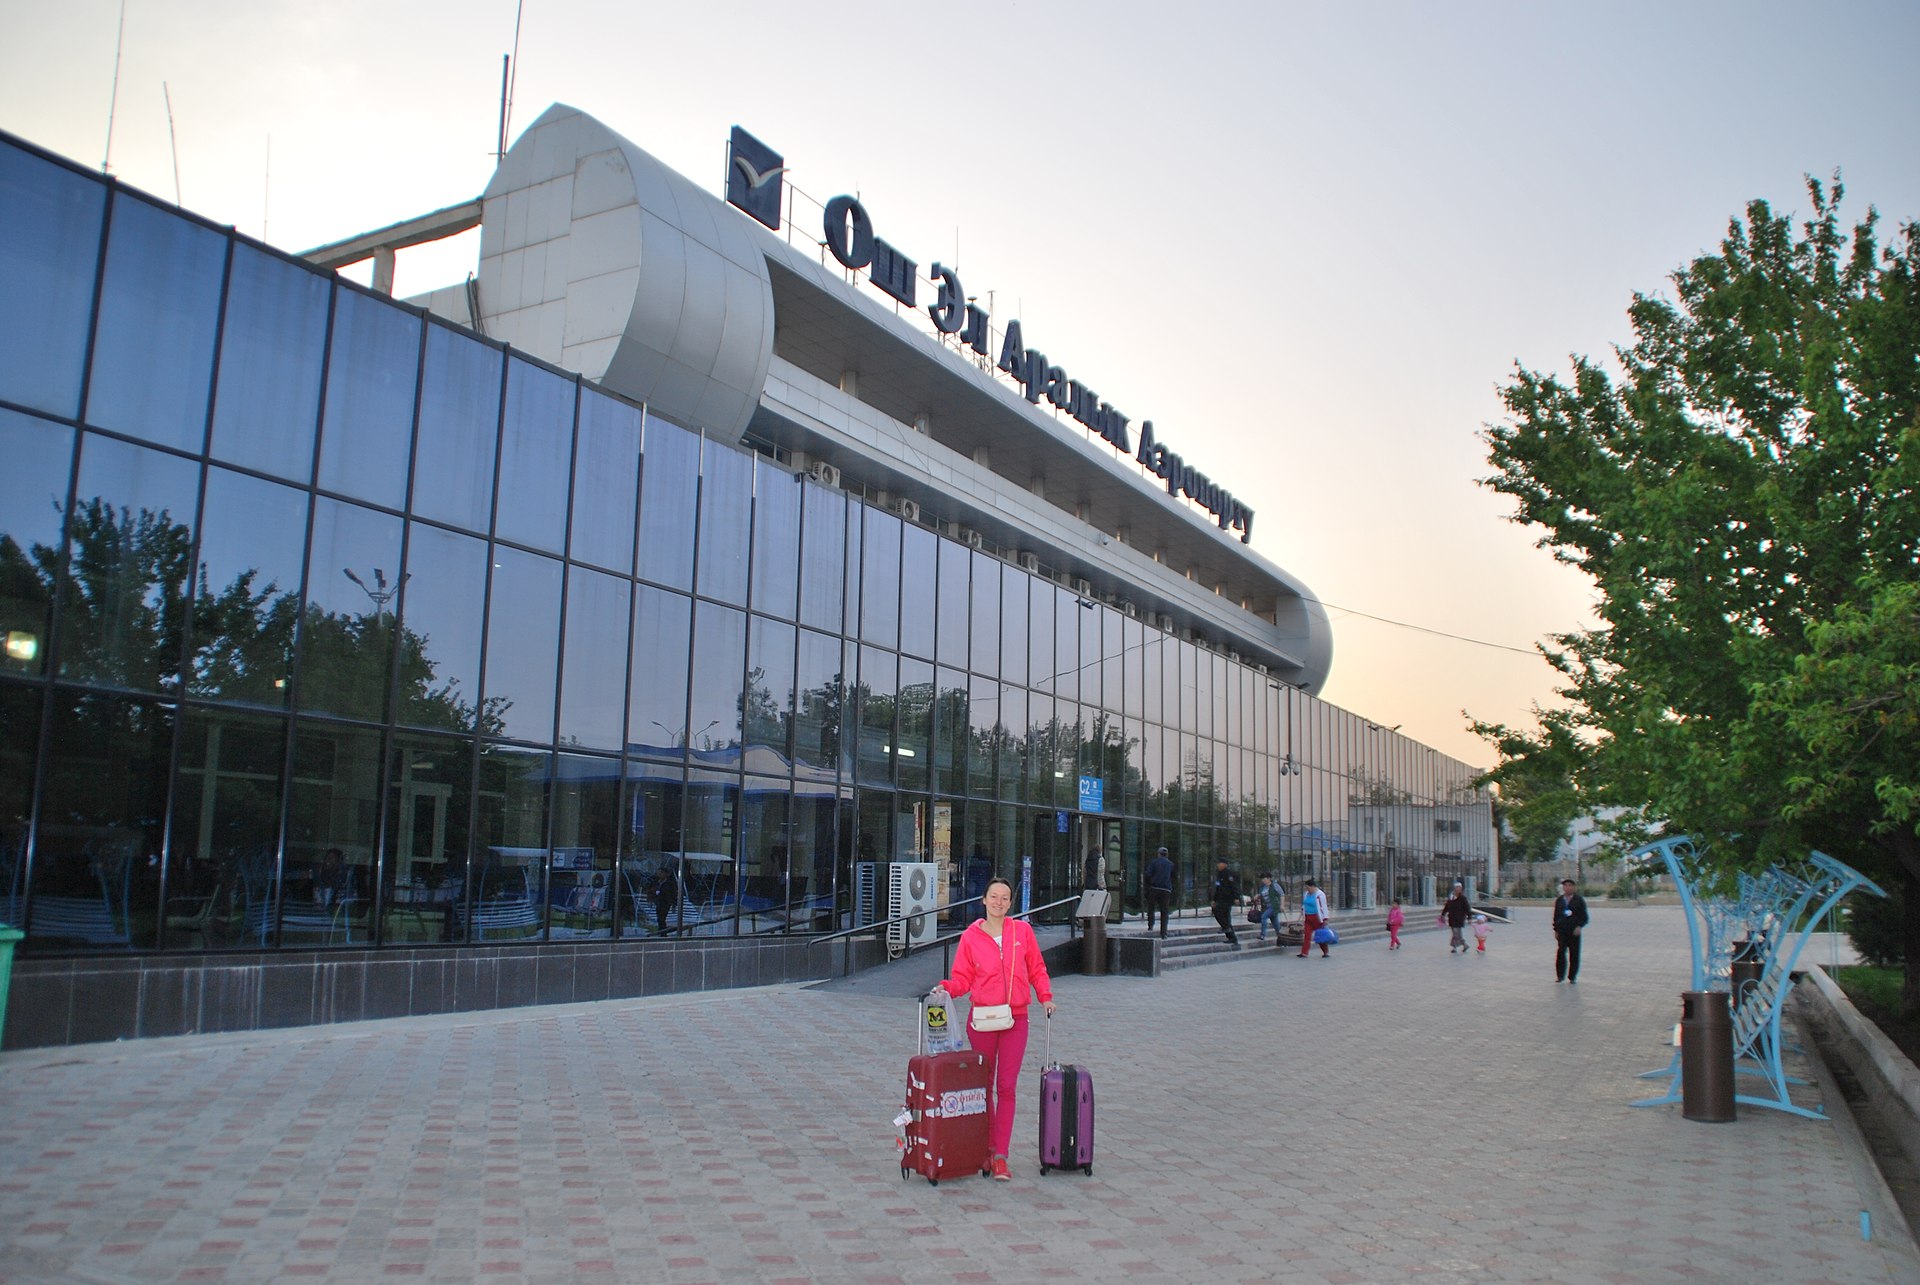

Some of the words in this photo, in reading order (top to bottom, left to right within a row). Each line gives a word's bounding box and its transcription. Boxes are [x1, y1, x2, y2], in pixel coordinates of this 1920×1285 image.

[824, 194, 918, 308] Ош
[928, 261, 990, 355] Эл
[997, 319, 1132, 453] Аралык
[1136, 420, 1256, 544] Аэропорту
[1080, 779, 1090, 795] C2
[928, 1011, 946, 1022] M
